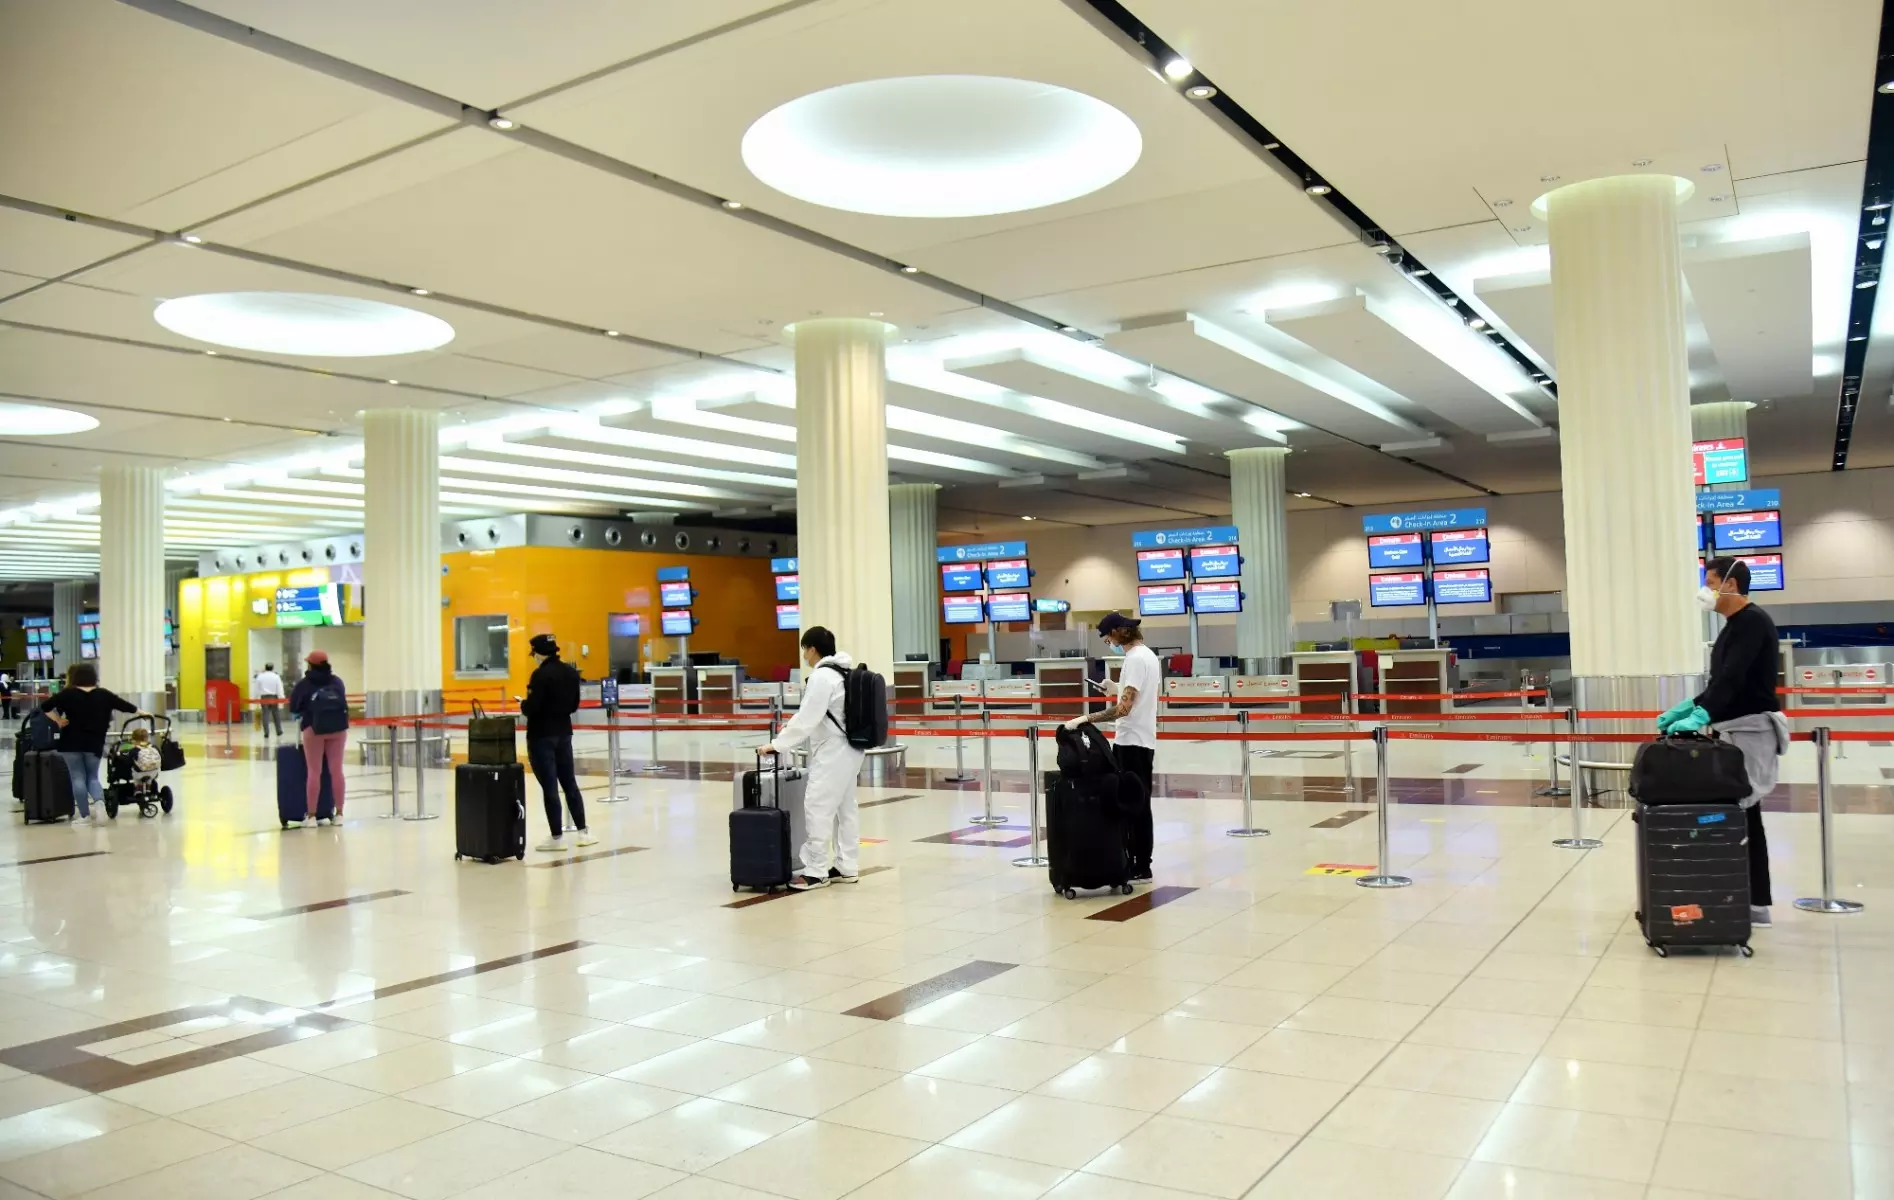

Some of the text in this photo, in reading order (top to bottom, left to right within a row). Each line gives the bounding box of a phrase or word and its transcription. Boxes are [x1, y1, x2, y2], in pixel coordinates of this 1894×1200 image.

[1736, 494, 1745, 506] 2
[1449, 513, 1457, 525] 2
[1206, 530, 1213, 541] 2
[999, 545, 1005, 555] 2
[1408, 732, 1434, 740] Emirates
